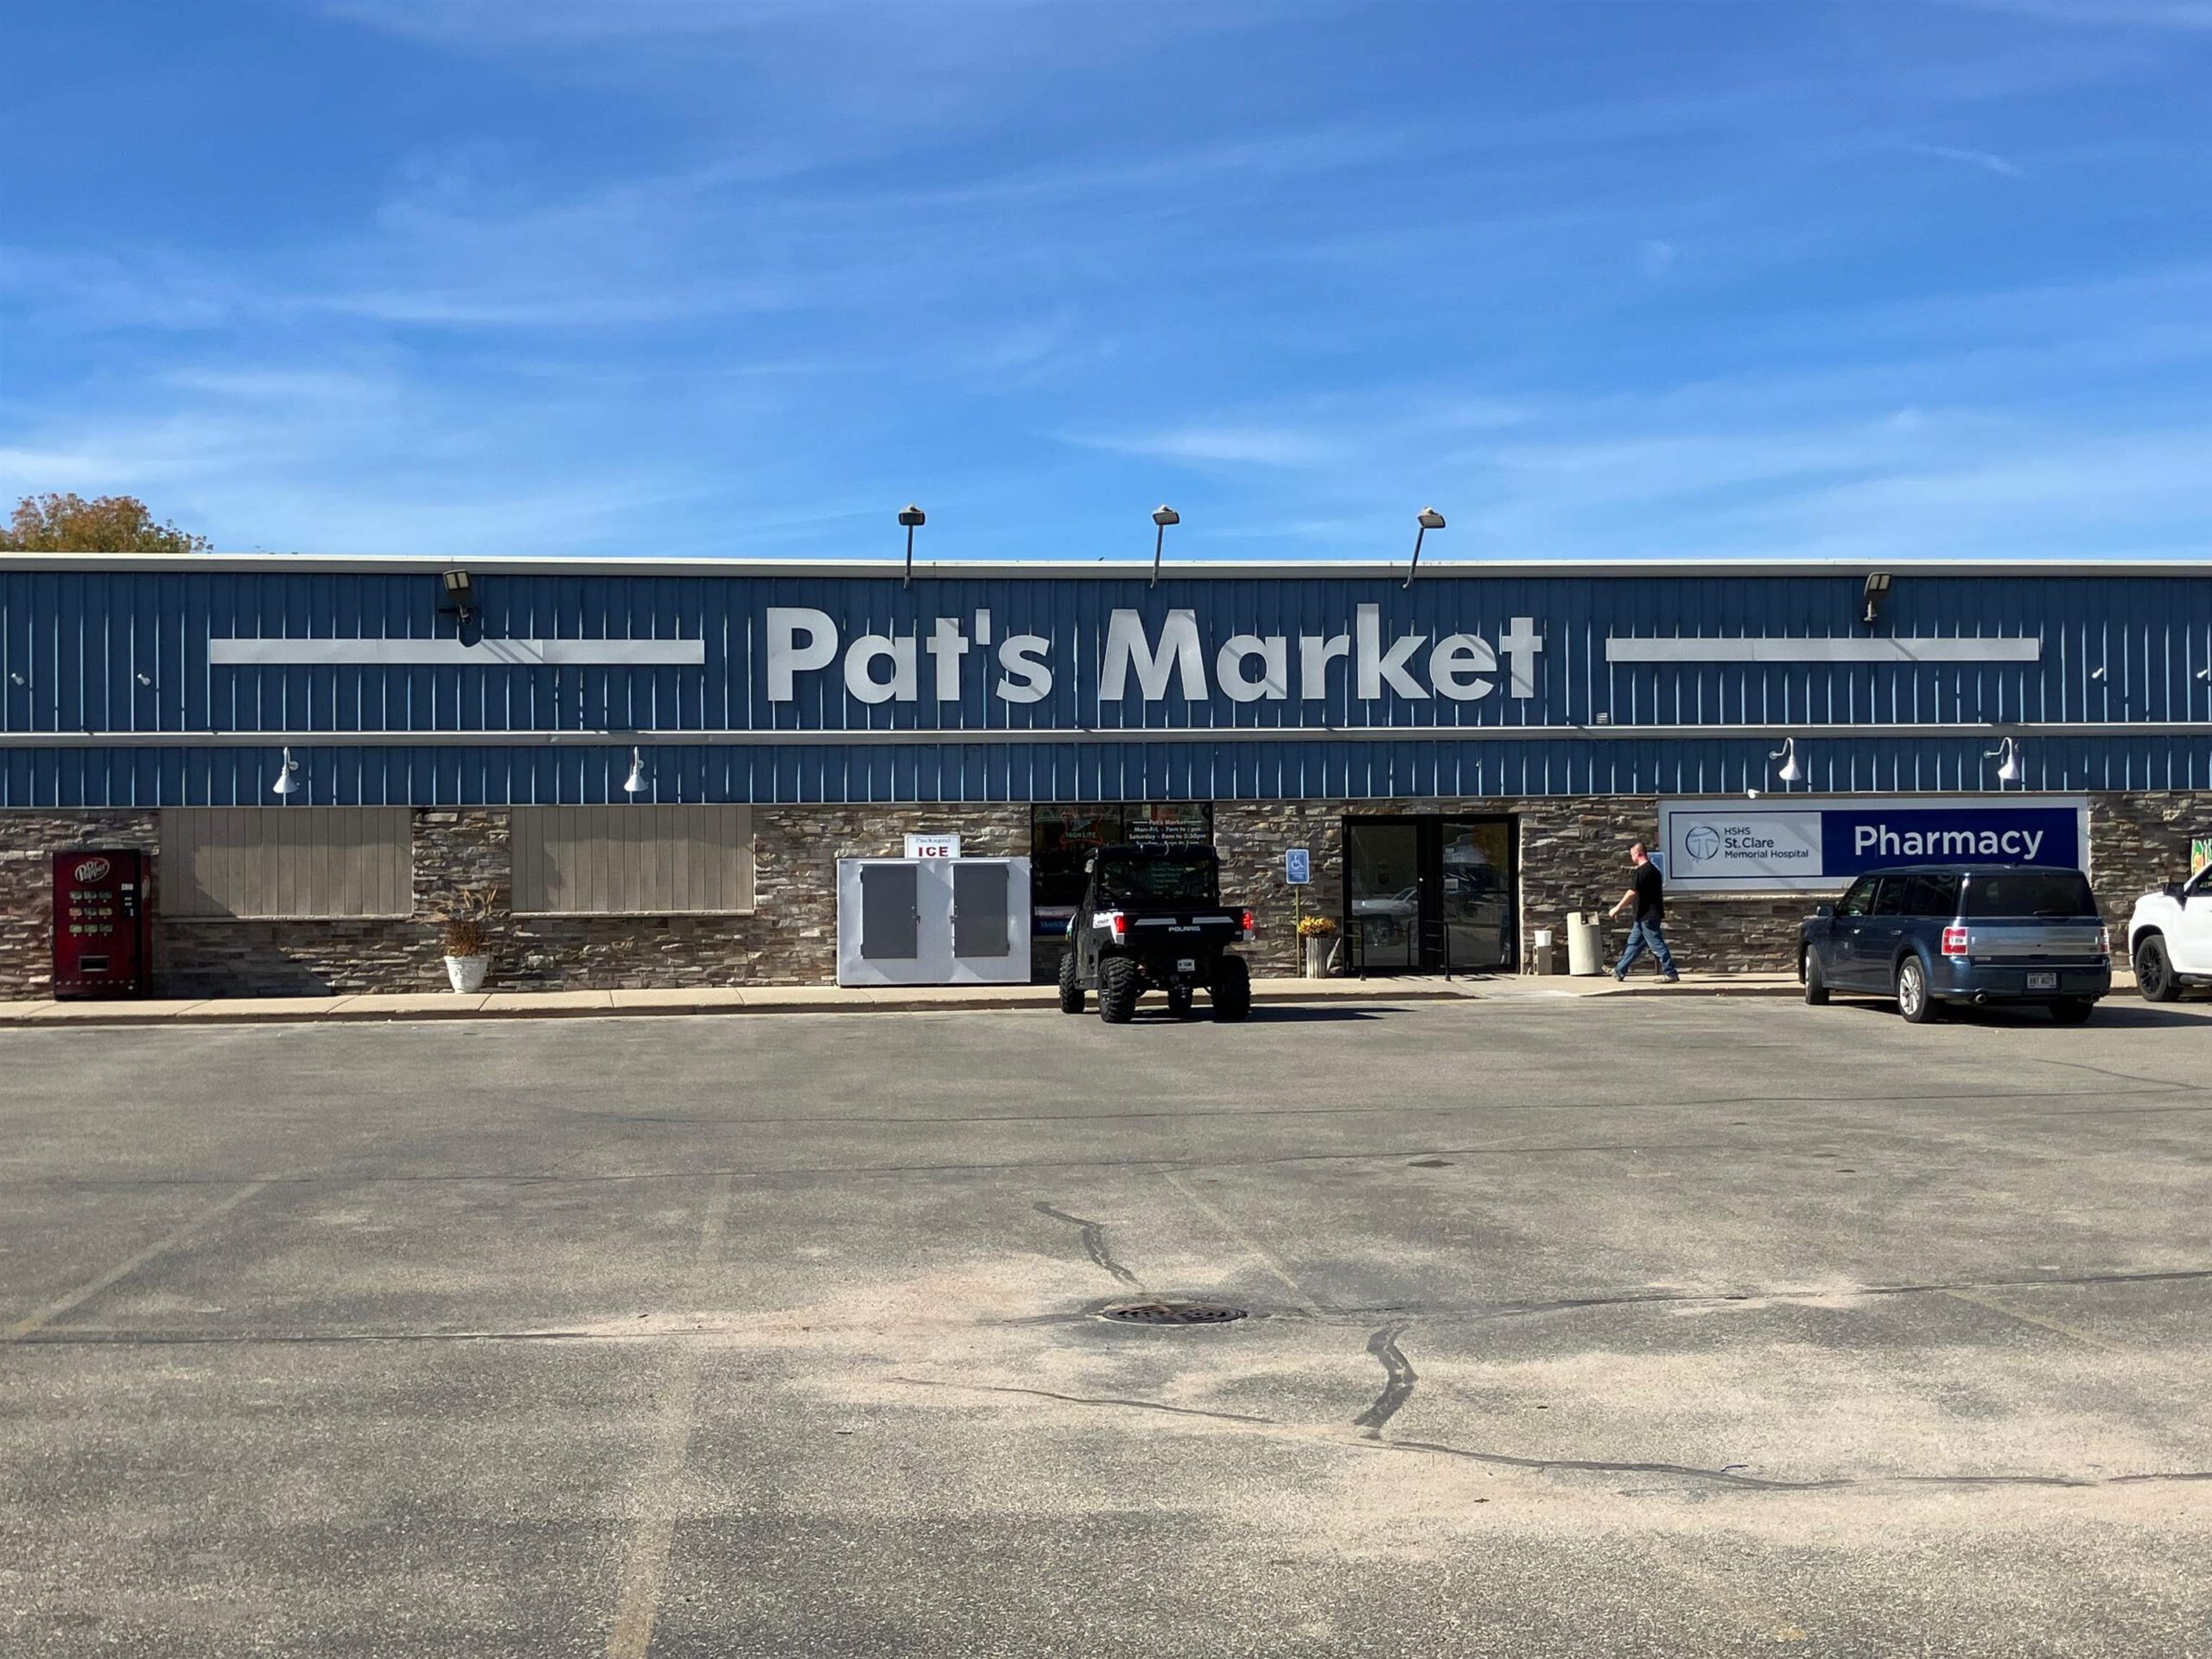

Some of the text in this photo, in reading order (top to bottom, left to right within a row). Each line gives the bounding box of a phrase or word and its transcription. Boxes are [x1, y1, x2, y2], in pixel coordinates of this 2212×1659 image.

[766, 603, 1543, 703] Pat's Market
[1724, 827, 1751, 836] HSHS
[1725, 837, 1775, 849] St. Clare
[1854, 824, 2044, 860] Pharmacy
[918, 846, 949, 857] ICE
[1770, 849, 1808, 859] Hospital
[86, 861, 99, 871] Dr
[76, 863, 106, 881] Pepper
